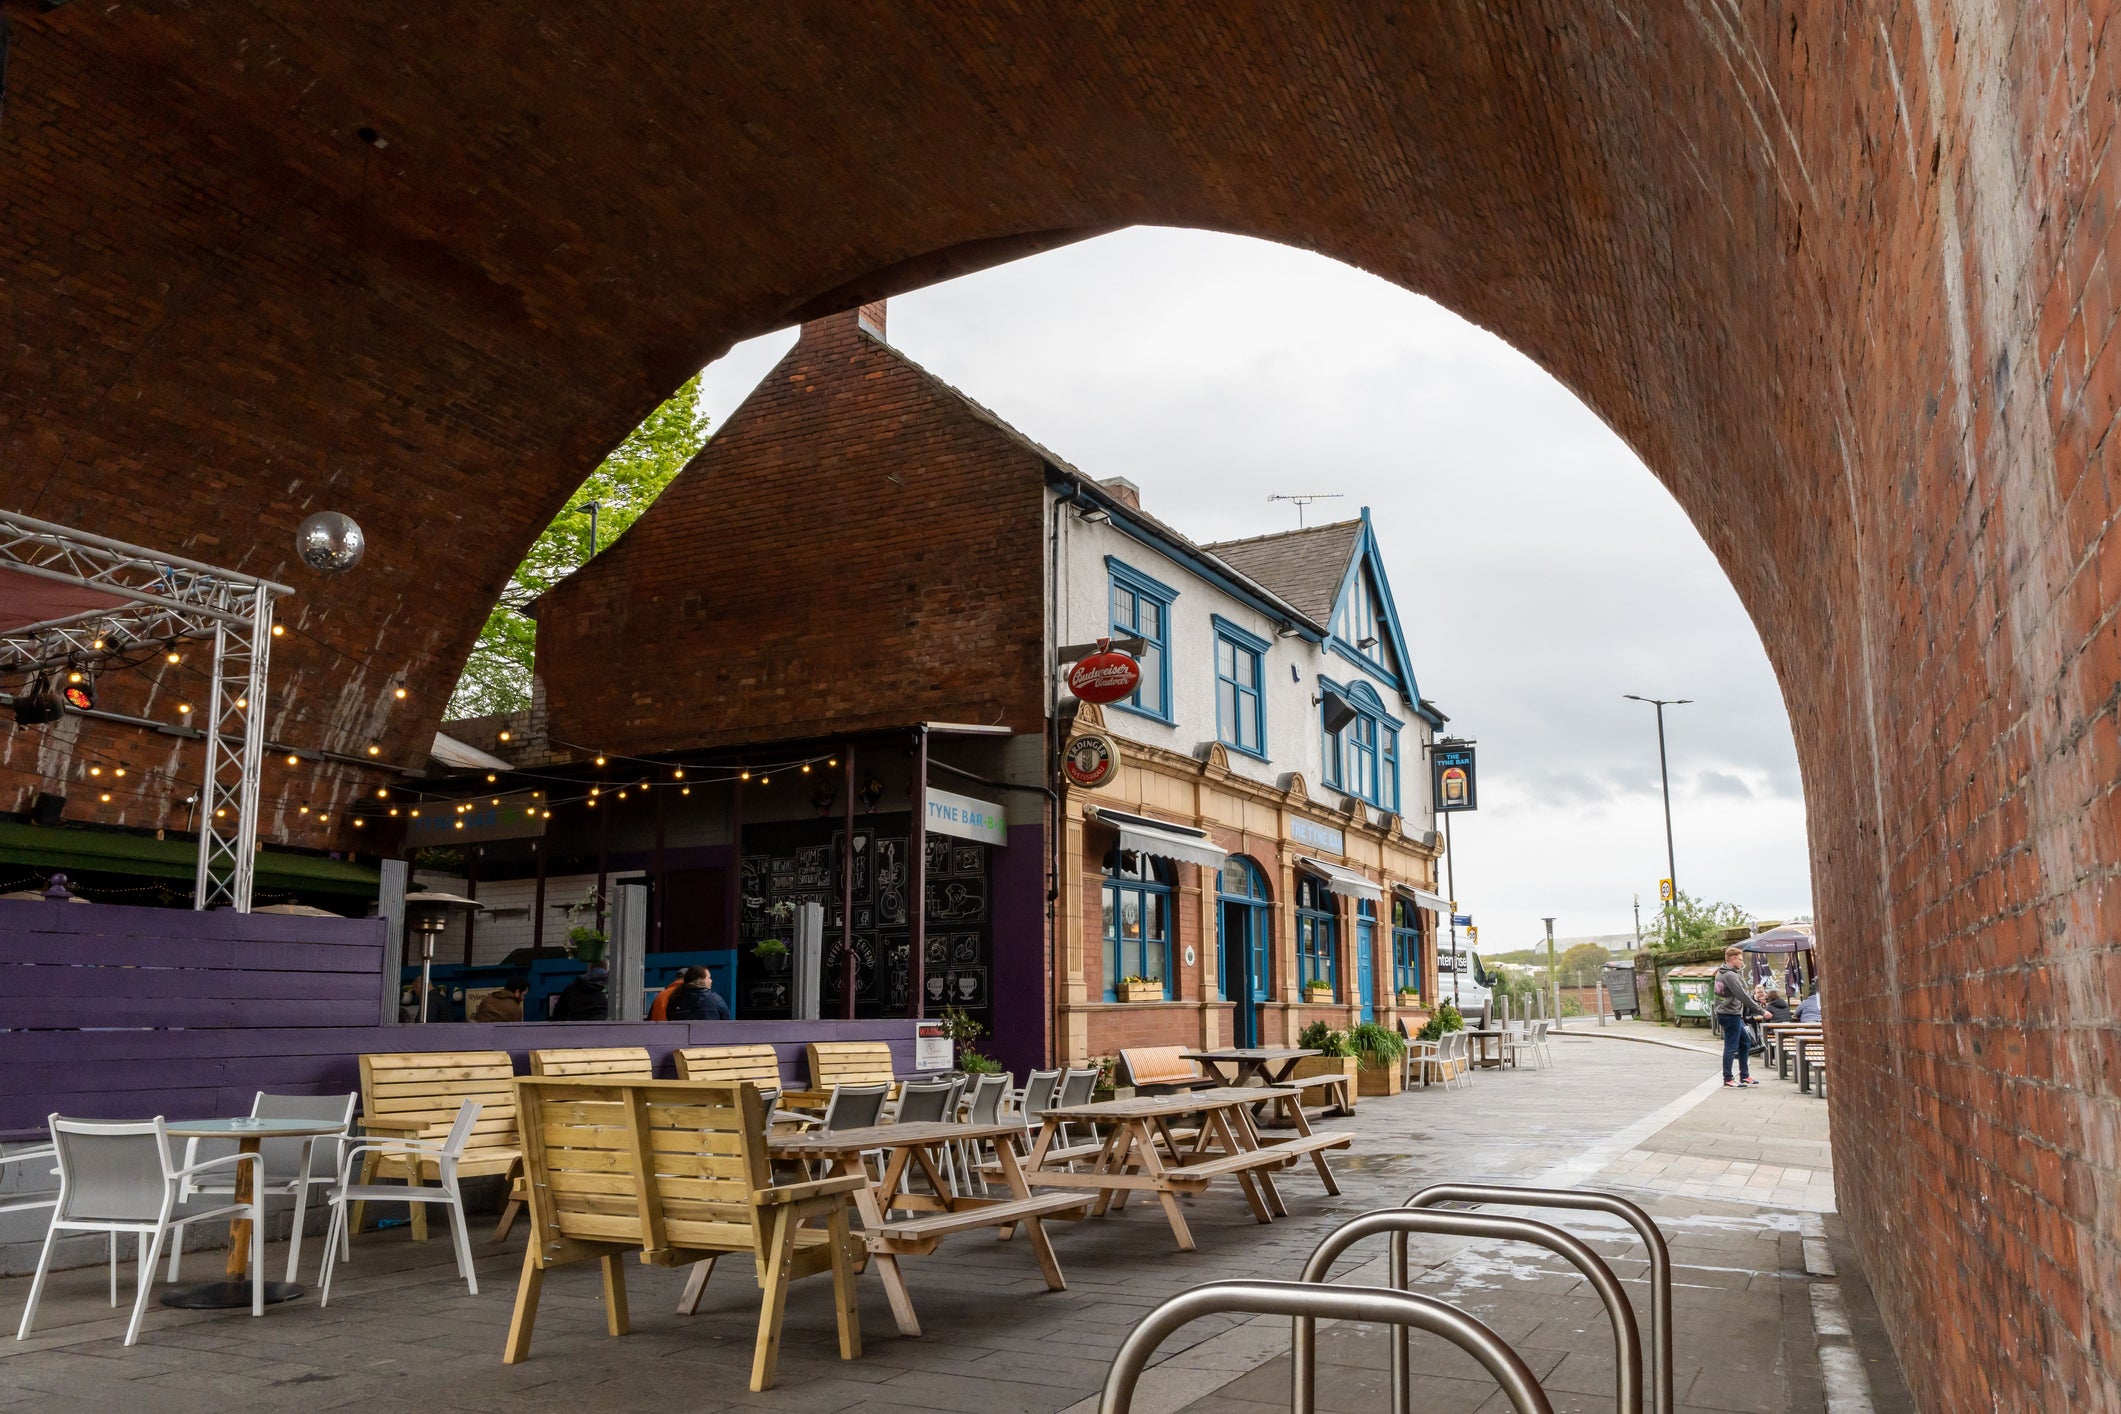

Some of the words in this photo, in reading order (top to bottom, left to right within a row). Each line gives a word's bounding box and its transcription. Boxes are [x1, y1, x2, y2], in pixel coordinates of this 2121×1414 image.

[1073, 664, 1129, 686] Budweiser
[1069, 740, 1106, 759] ERDINGER
[928, 802, 957, 822] TYNE
[1291, 820, 1306, 839] THE
[1309, 827, 1327, 845] TYNE
[1662, 885, 1670, 894] 20
[856, 938, 875, 967] FRIEND
